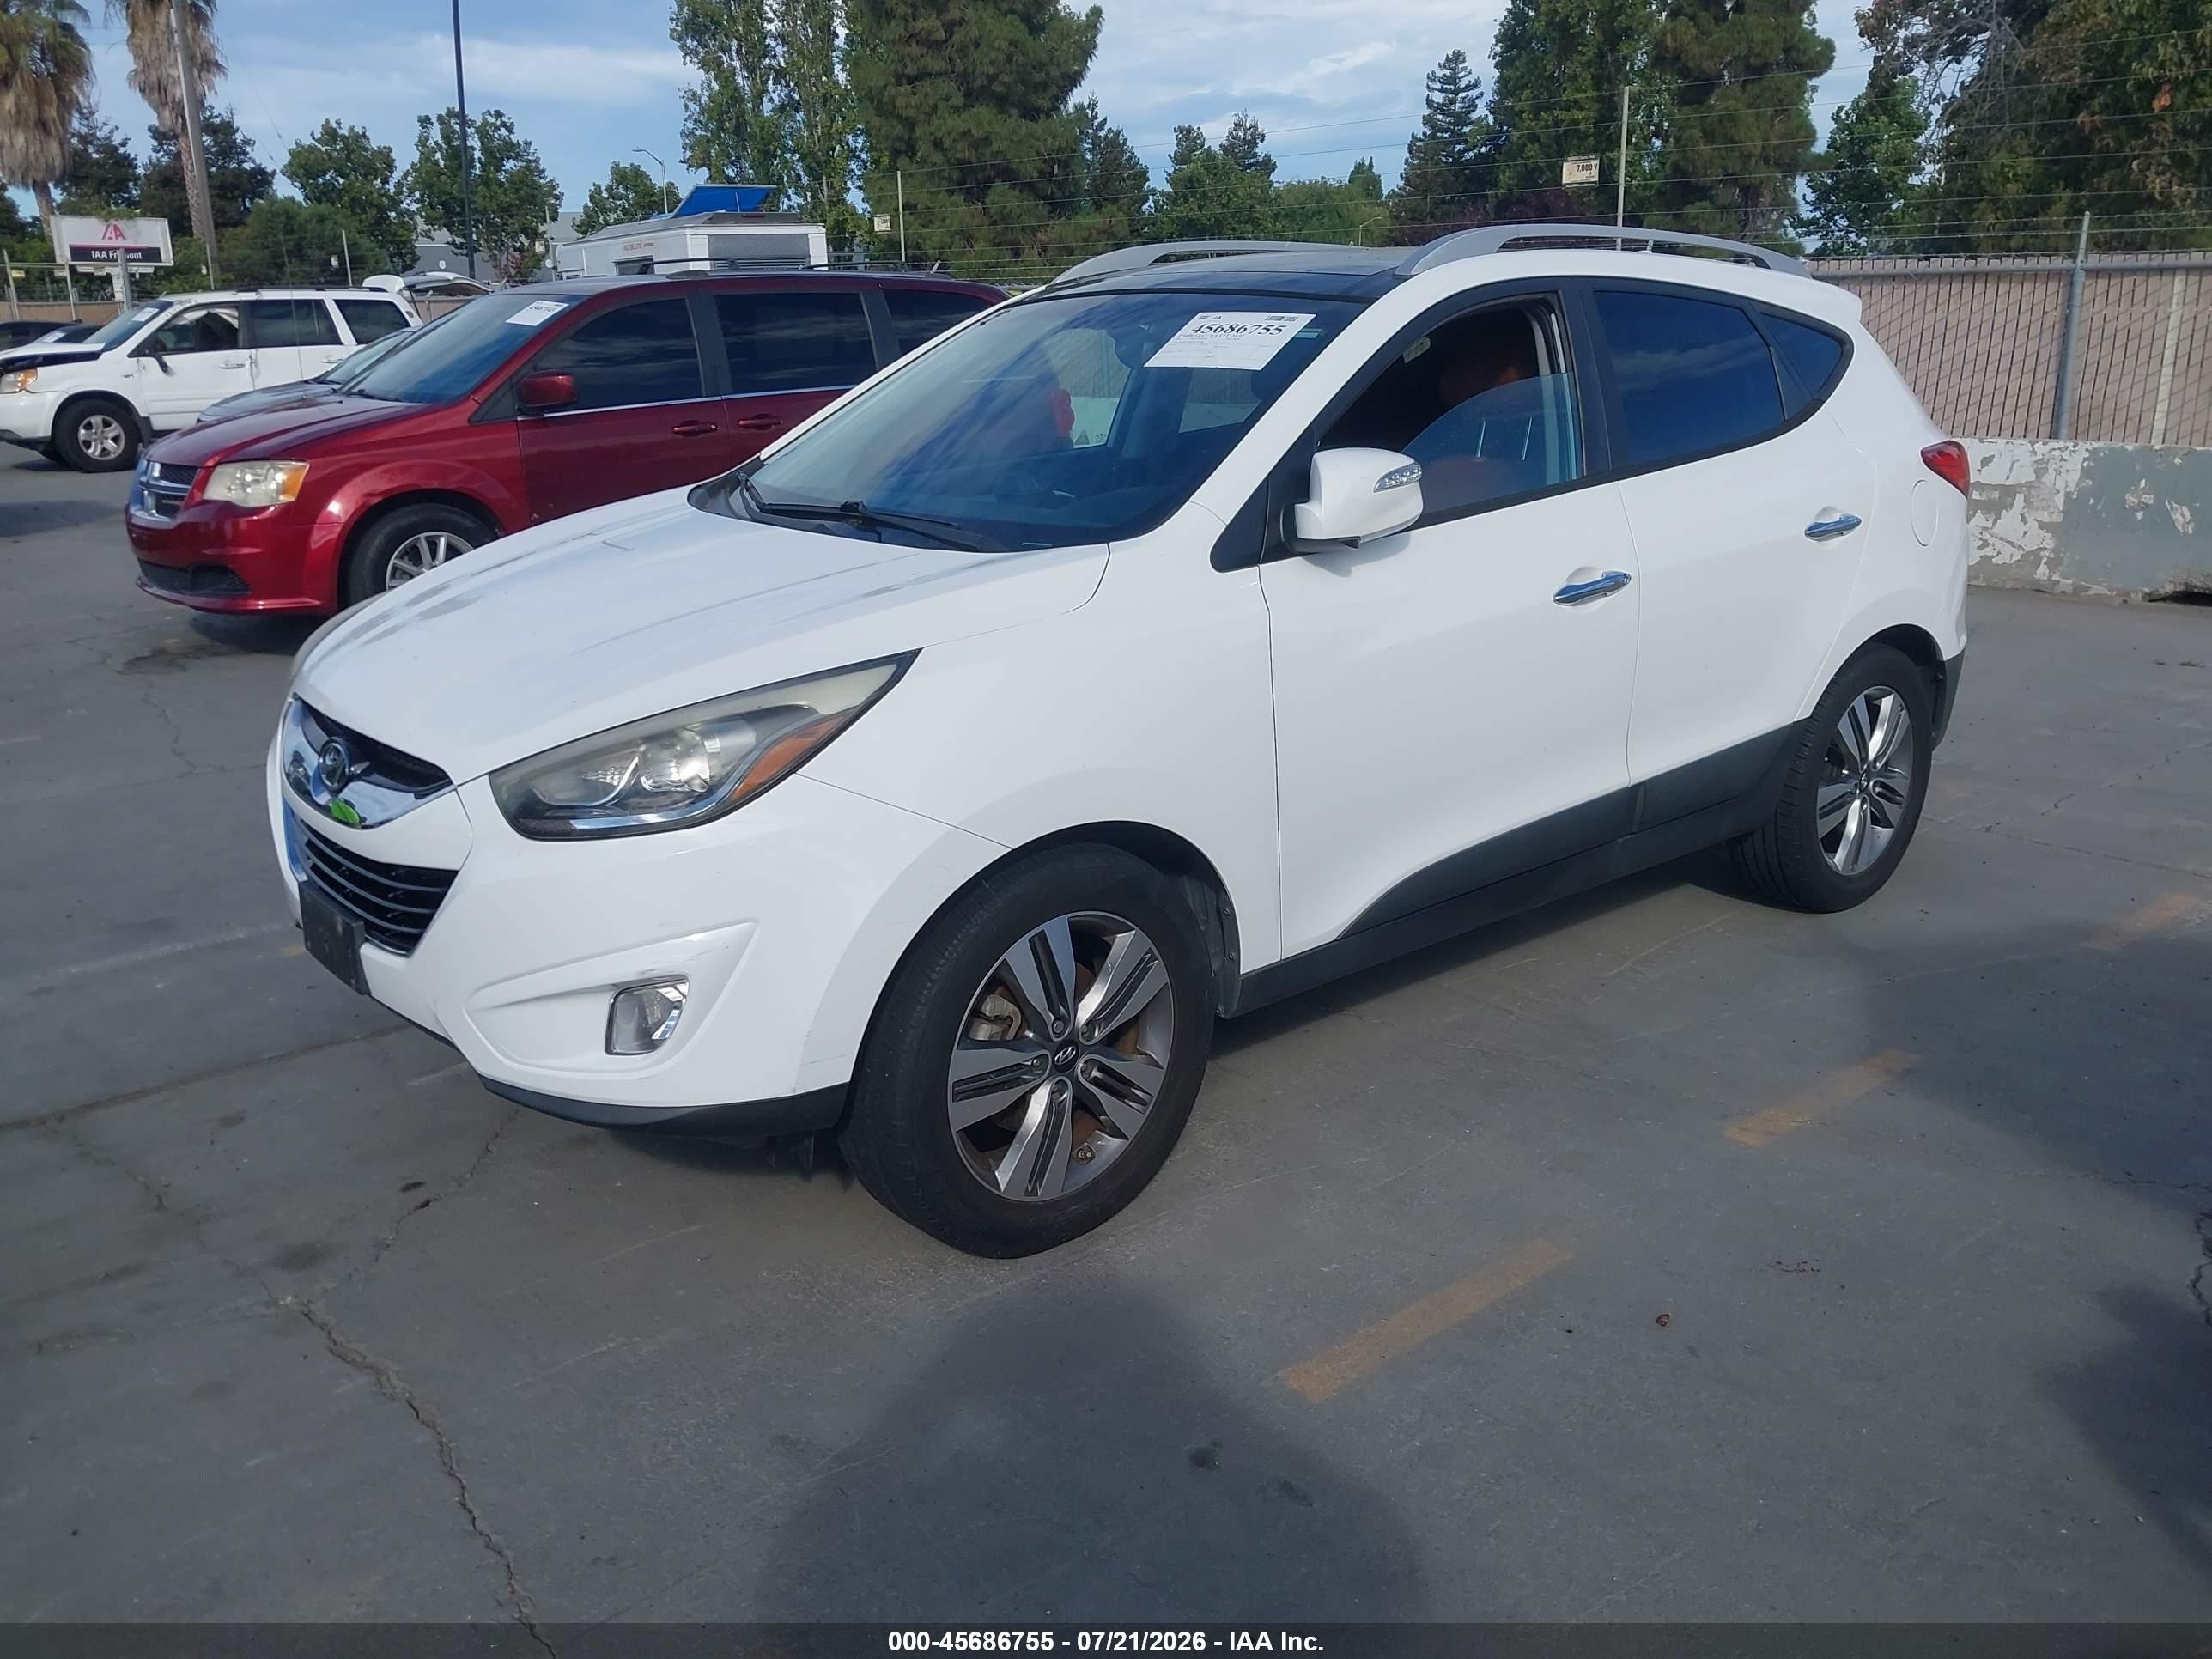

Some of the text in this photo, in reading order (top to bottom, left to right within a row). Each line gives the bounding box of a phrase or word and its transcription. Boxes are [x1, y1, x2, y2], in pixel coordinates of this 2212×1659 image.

[1577, 163, 1593, 173] 7,000
[91, 250, 142, 259] IAA Front
[1191, 323, 1286, 335] 45686755
